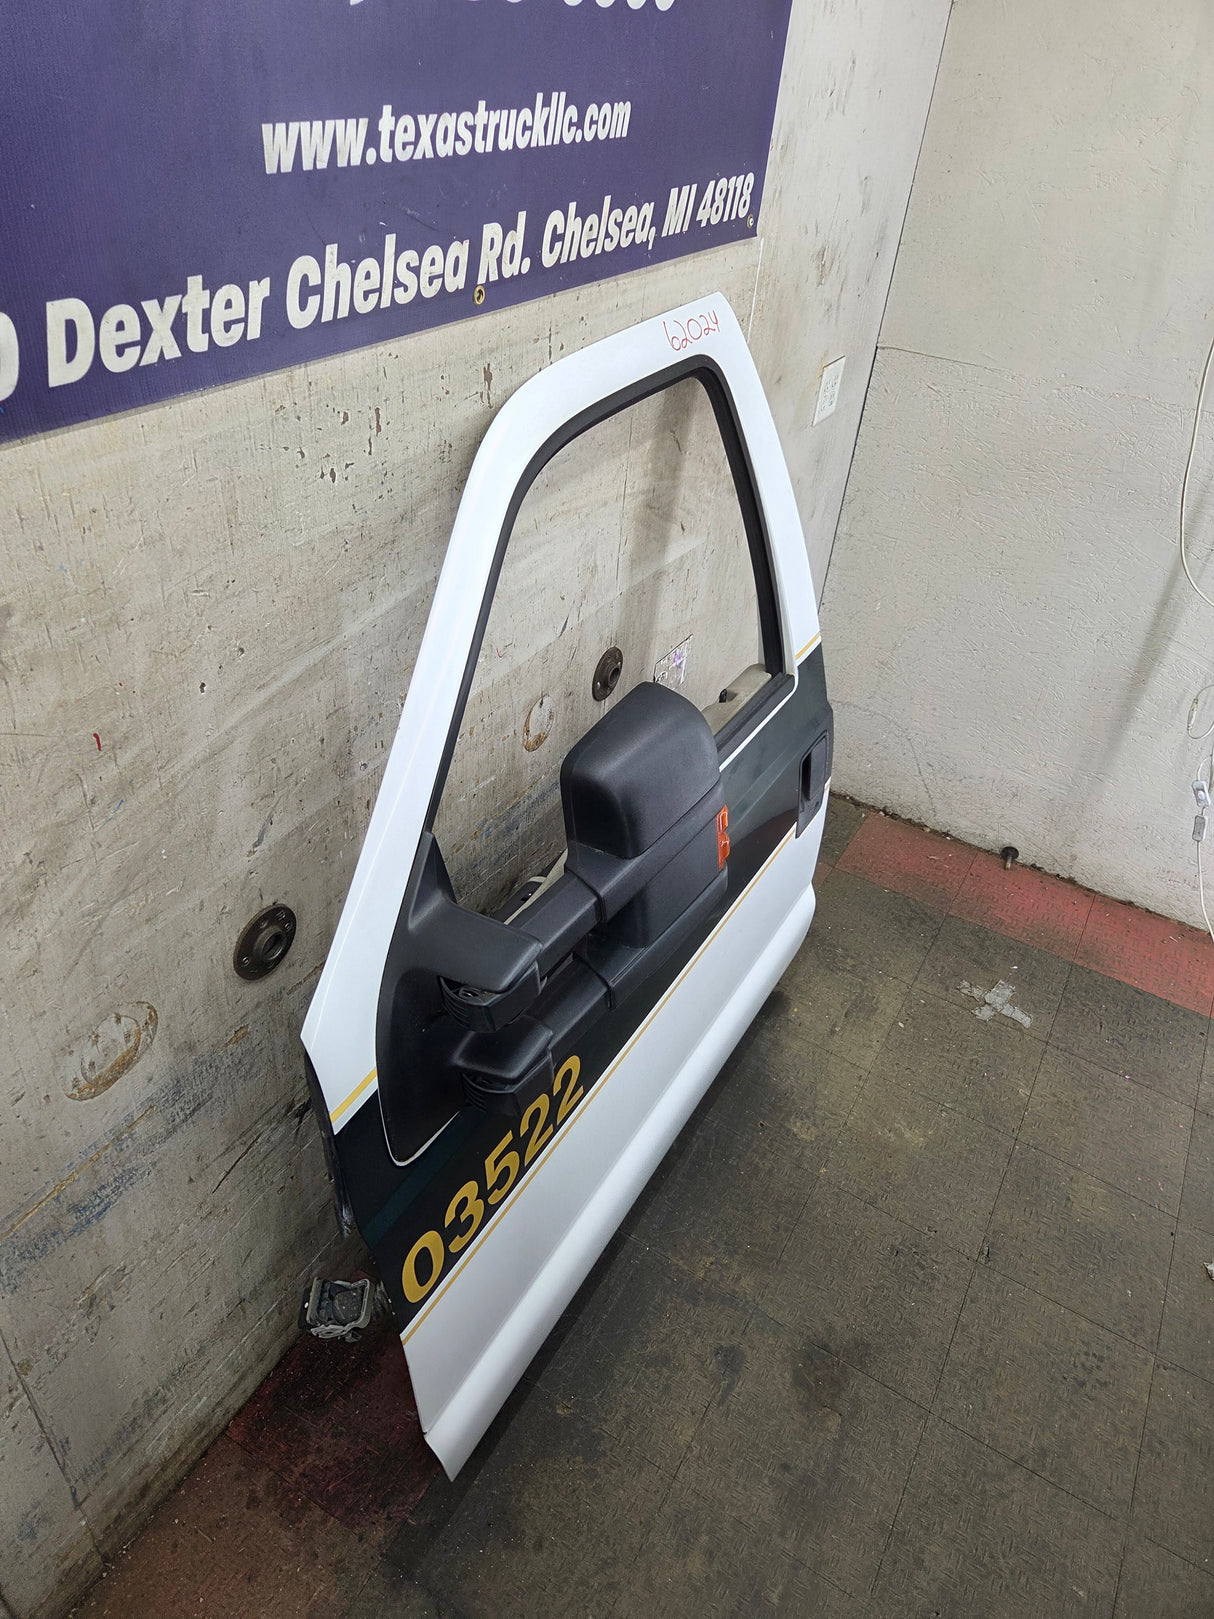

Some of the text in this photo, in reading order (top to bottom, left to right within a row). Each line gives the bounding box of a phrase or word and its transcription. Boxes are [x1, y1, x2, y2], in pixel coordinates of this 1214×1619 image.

[261, 91, 632, 175] www.texastruckllc.com
[46, 275, 271, 388] Dexter
[285, 233, 470, 330] Chelsea
[477, 210, 531, 285] Rd.
[541, 195, 656, 267] Chelsea,
[662, 185, 697, 237] MI
[697, 172, 755, 228] 48118
[663, 310, 720, 351] 62024
[401, 1054, 584, 1304] 03522
